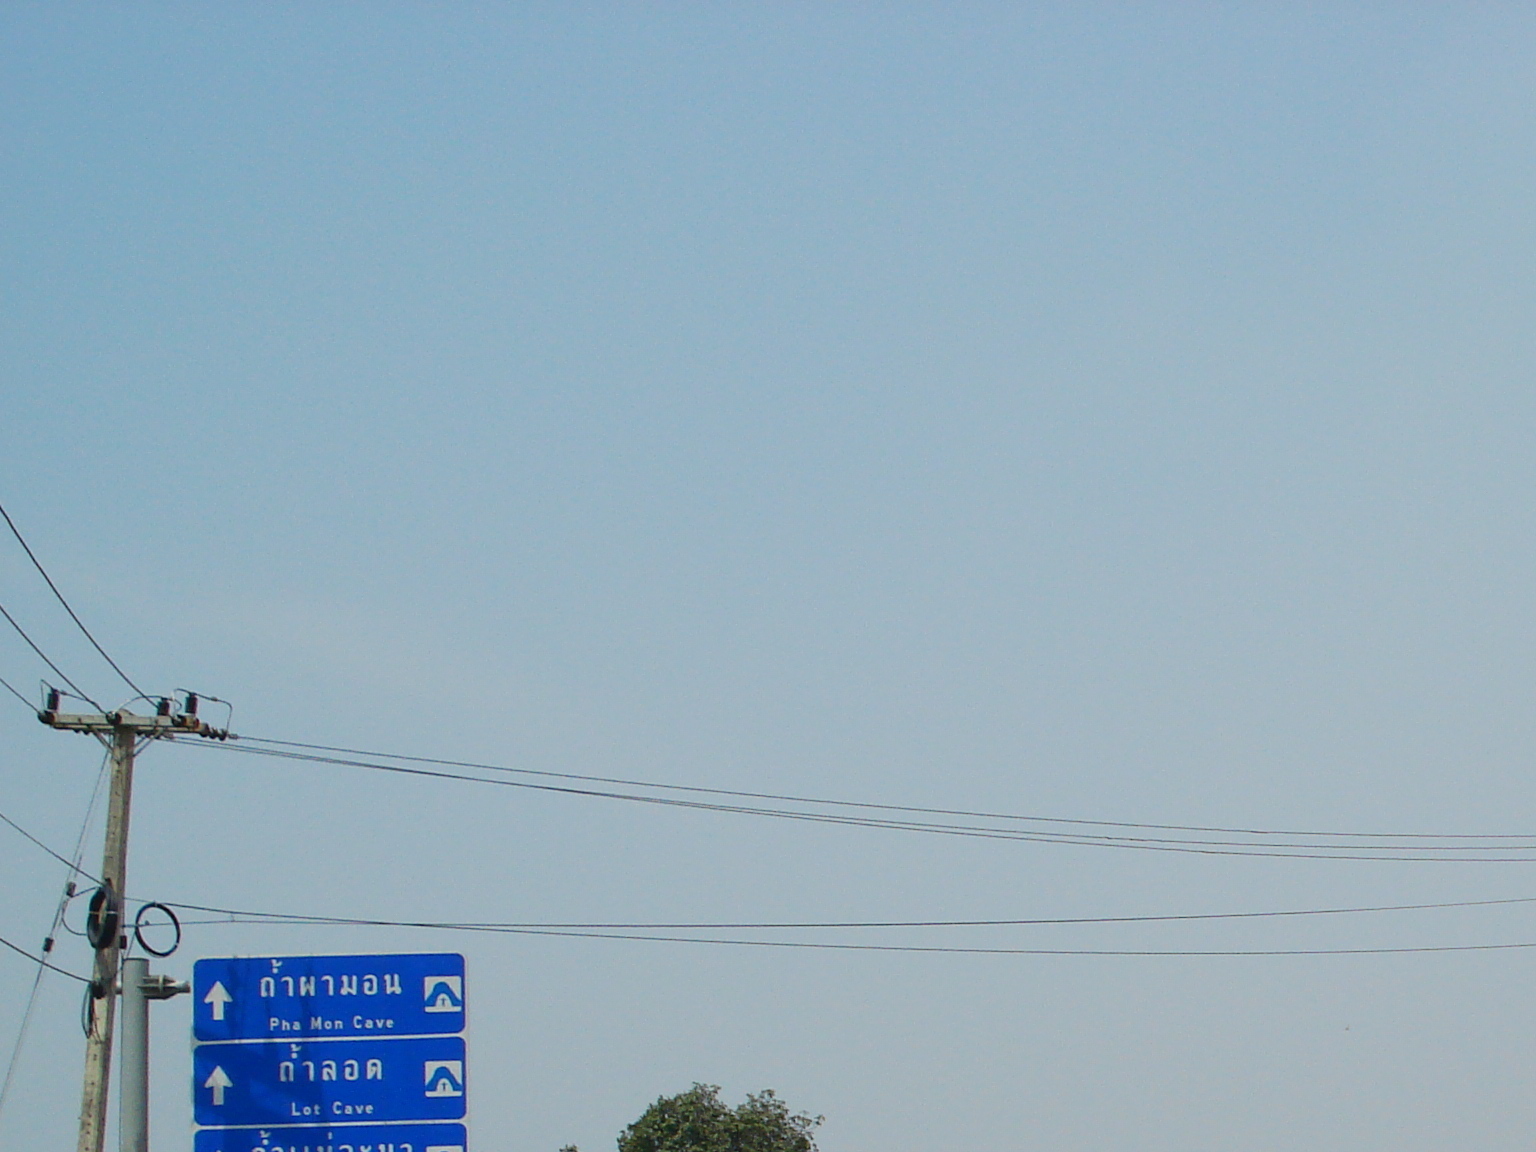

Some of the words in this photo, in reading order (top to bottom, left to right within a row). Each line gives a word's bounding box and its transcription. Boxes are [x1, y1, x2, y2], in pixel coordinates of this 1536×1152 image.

[260, 959, 402, 998] ถ้ำผามอน
[270, 1017, 301, 1031] Pha
[310, 1016, 343, 1031] Mon
[353, 1015, 395, 1030] Cave
[279, 1044, 383, 1082] ถ้ำลอด
[291, 1102, 321, 1116] Lot
[333, 1101, 374, 1115] Cave
